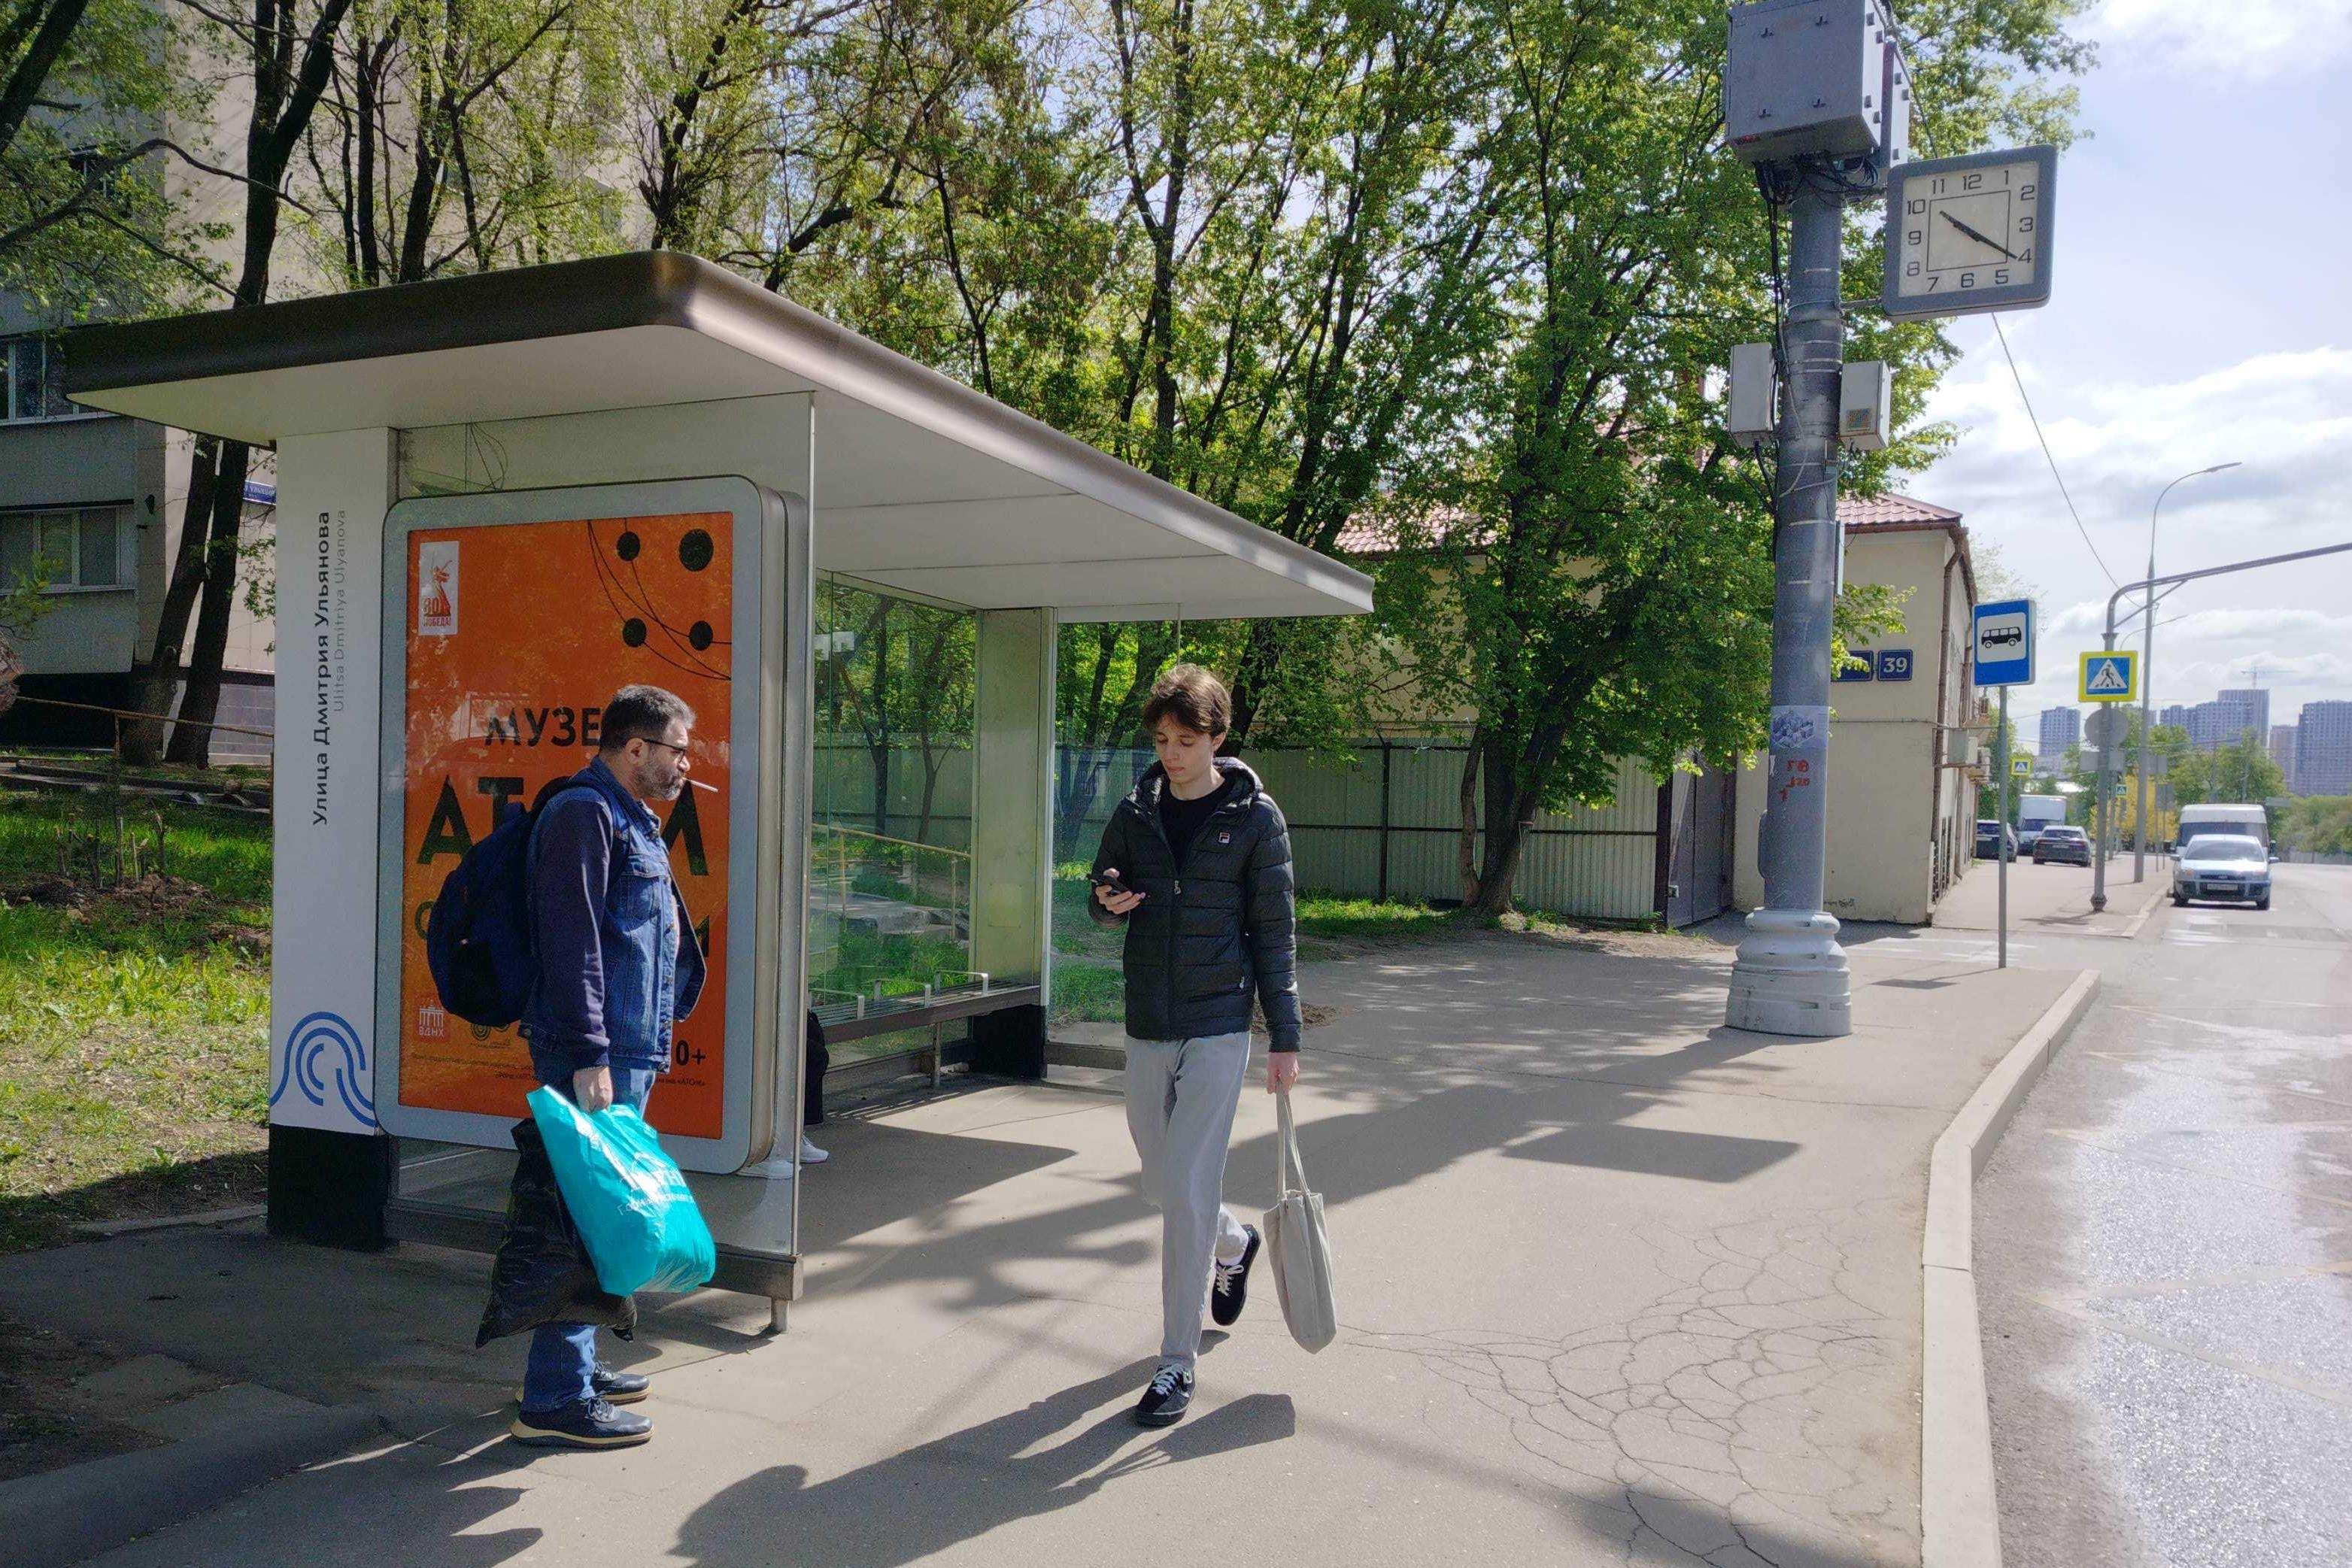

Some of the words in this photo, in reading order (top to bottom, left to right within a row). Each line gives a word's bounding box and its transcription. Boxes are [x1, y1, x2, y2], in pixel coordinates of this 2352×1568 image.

[1962, 174, 1982, 190] 12
[2005, 170, 2010, 185] 1
[1932, 179, 1945, 194] 11
[2020, 185, 2035, 202] 2
[1907, 199, 1926, 215] 10
[2019, 217, 2034, 233] 3
[1907, 230, 1923, 246] 9
[2017, 248, 2032, 264] 4
[1907, 261, 1920, 278] 8
[1995, 269, 2009, 285] 5
[1927, 277, 1939, 293] 7
[1960, 273, 1974, 288] 6
[334, 510, 347, 584] Ulyanova
[314, 511, 329, 627] Ульянова
[334, 589, 347, 660] Dmitriya
[1883, 657, 1907, 673] 39
[313, 635, 332, 746] Дмитрия
[333, 666, 344, 712] Ulitsa
[484, 707, 602, 747] МУЗЕ
[313, 752, 330, 825] Улица
[419, 1026, 445, 1038] ВДНХ
